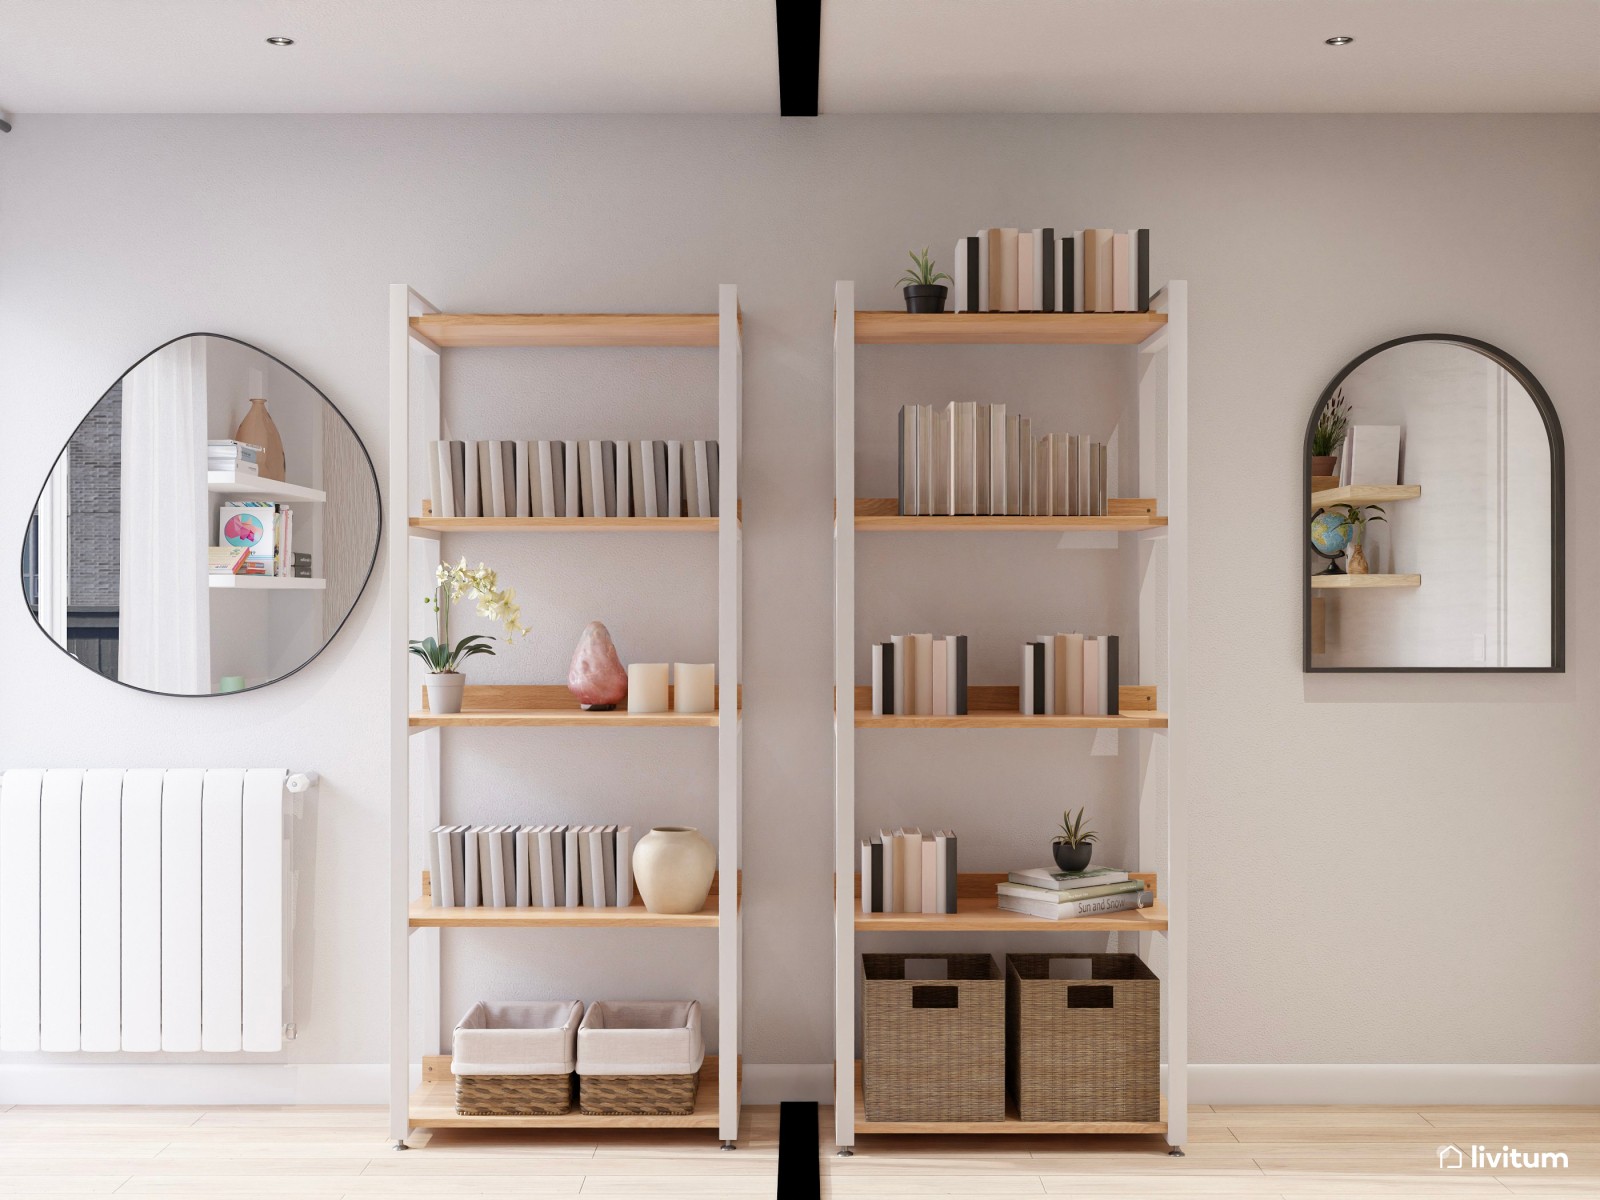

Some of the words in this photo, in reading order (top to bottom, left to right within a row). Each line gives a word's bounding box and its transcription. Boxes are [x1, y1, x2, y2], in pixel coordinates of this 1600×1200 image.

[1078, 902, 1091, 913] Sun
[1092, 899, 1105, 911] and
[1106, 898, 1125, 909] Snow
